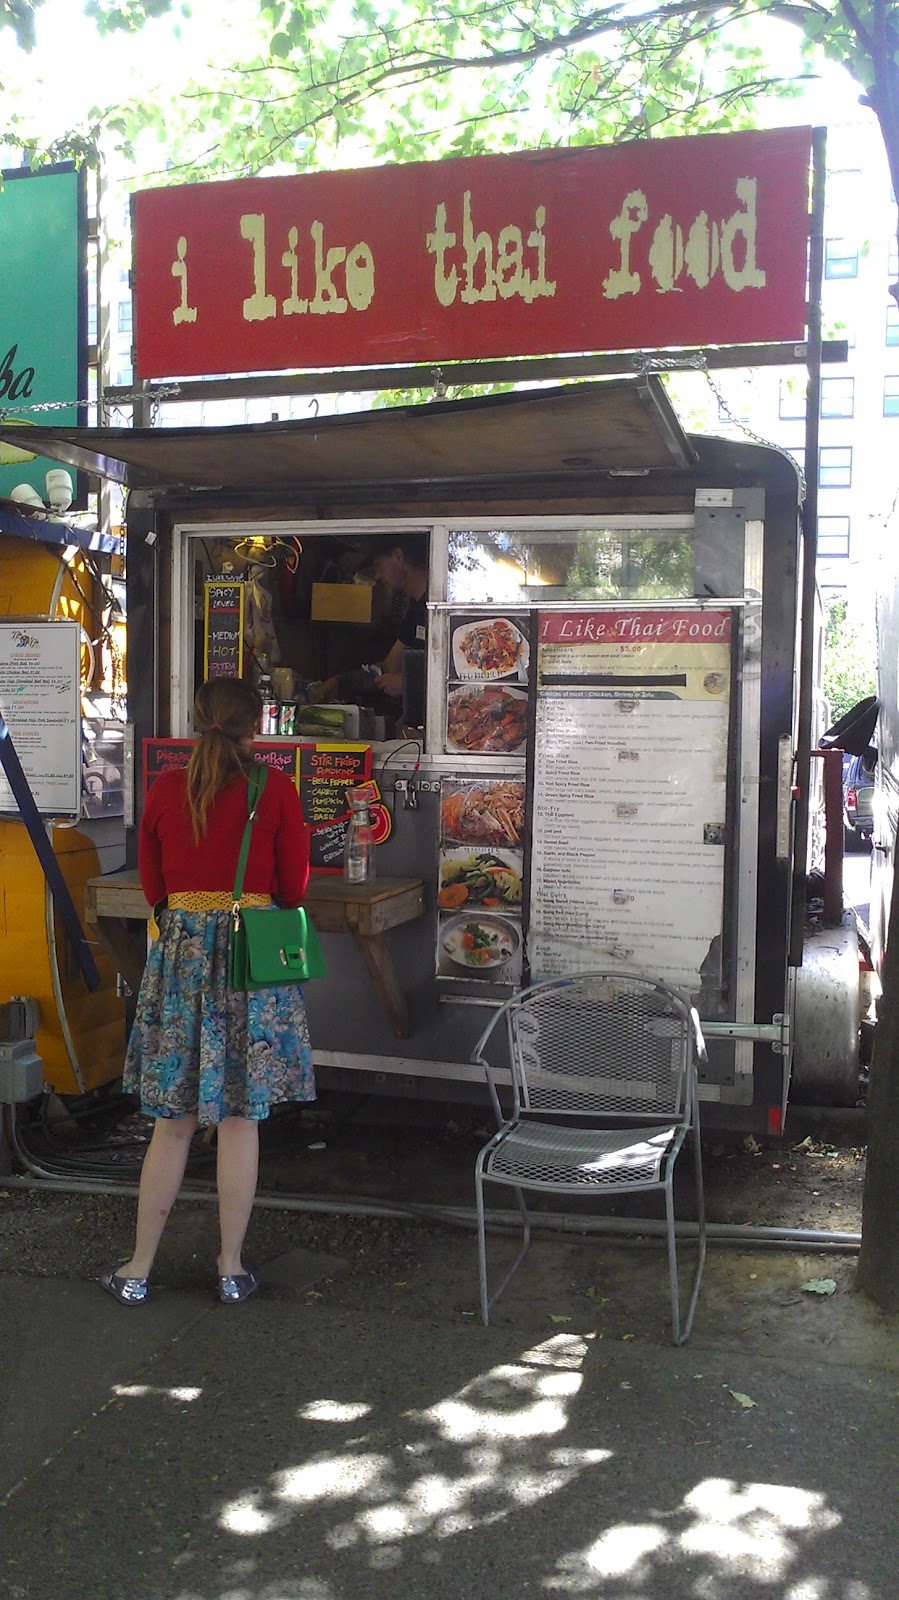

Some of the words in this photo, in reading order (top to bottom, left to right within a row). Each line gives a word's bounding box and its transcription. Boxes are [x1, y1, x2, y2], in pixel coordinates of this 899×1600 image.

[171, 235, 197, 325] i
[239, 213, 376, 322] like
[426, 190, 557, 307] thai
[602, 176, 766, 299] food
[213, 600, 235, 608] LEVEL
[541, 620, 551, 637] I
[559, 618, 606, 640] Like
[615, 618, 664, 637] Thai
[673, 617, 731, 637] Food
[310, 754, 333, 766] STIR
[335, 755, 361, 767] FRIED
